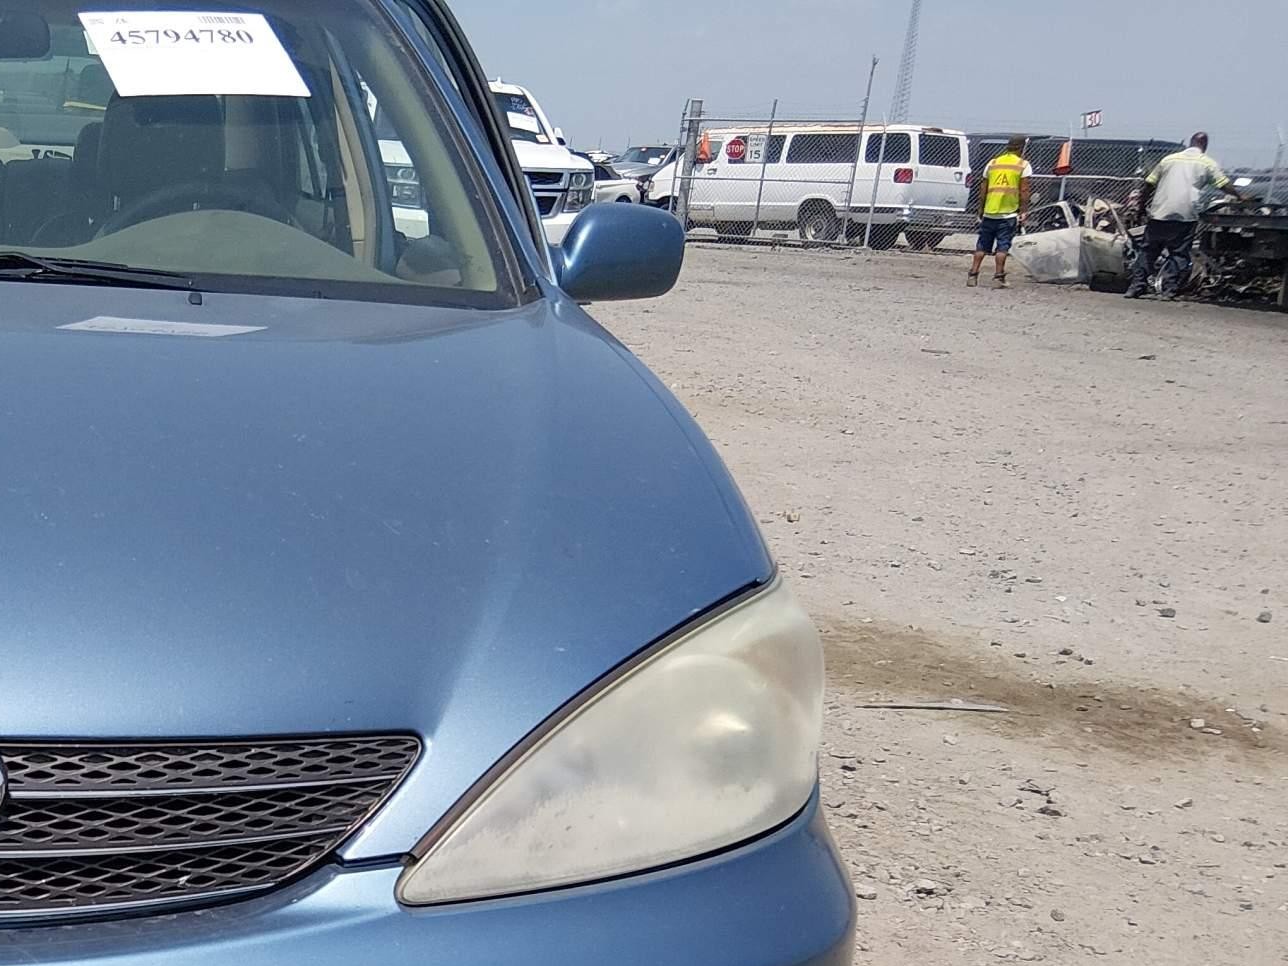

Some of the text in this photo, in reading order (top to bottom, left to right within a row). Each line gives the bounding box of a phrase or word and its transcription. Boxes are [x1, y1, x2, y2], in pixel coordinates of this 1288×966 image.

[110, 28, 254, 45] 45794780
[726, 144, 744, 153] STOP
[750, 150, 760, 159] 15
